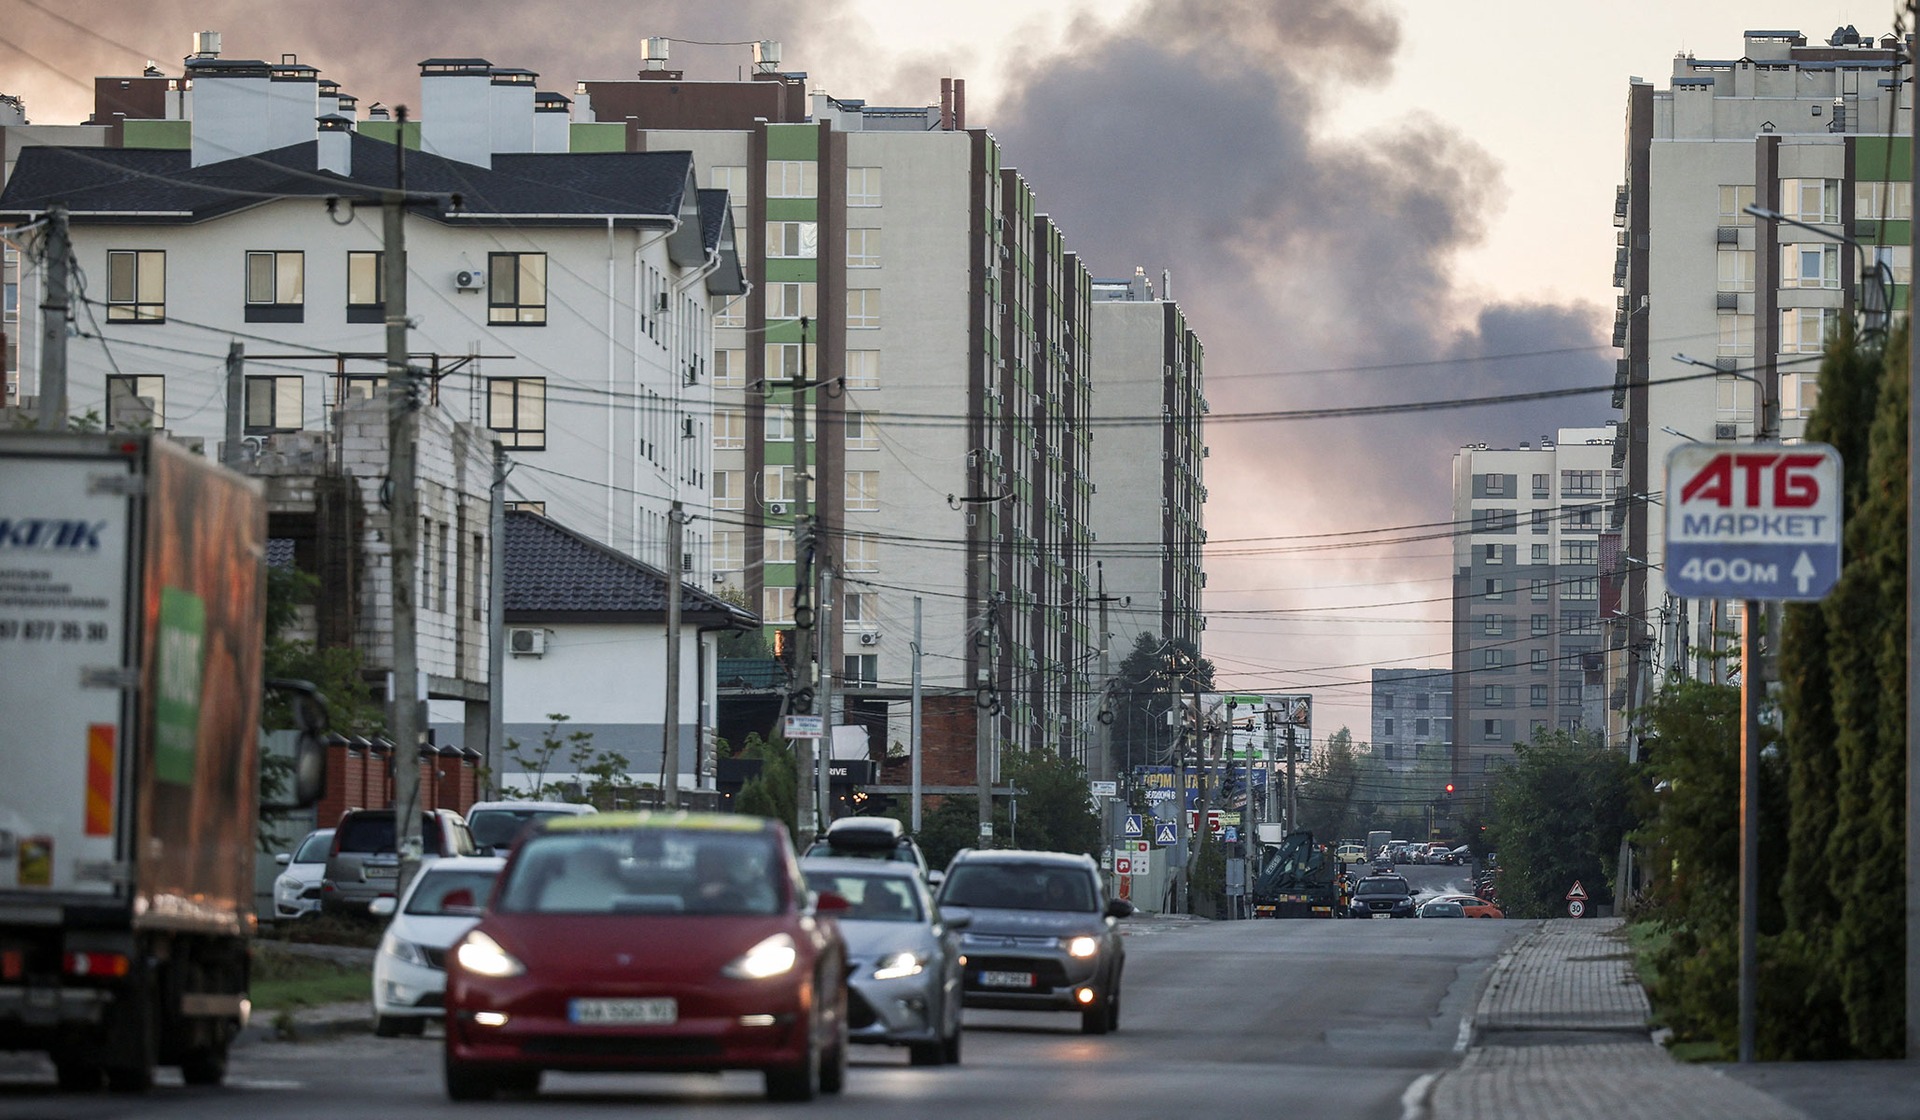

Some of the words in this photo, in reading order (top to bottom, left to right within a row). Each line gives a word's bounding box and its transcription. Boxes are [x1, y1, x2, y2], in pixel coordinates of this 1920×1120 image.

[1681, 453, 1826, 508] АТБ
[1683, 513, 1826, 536] МАРКЕТ
[829, 767, 848, 776] RIVE
